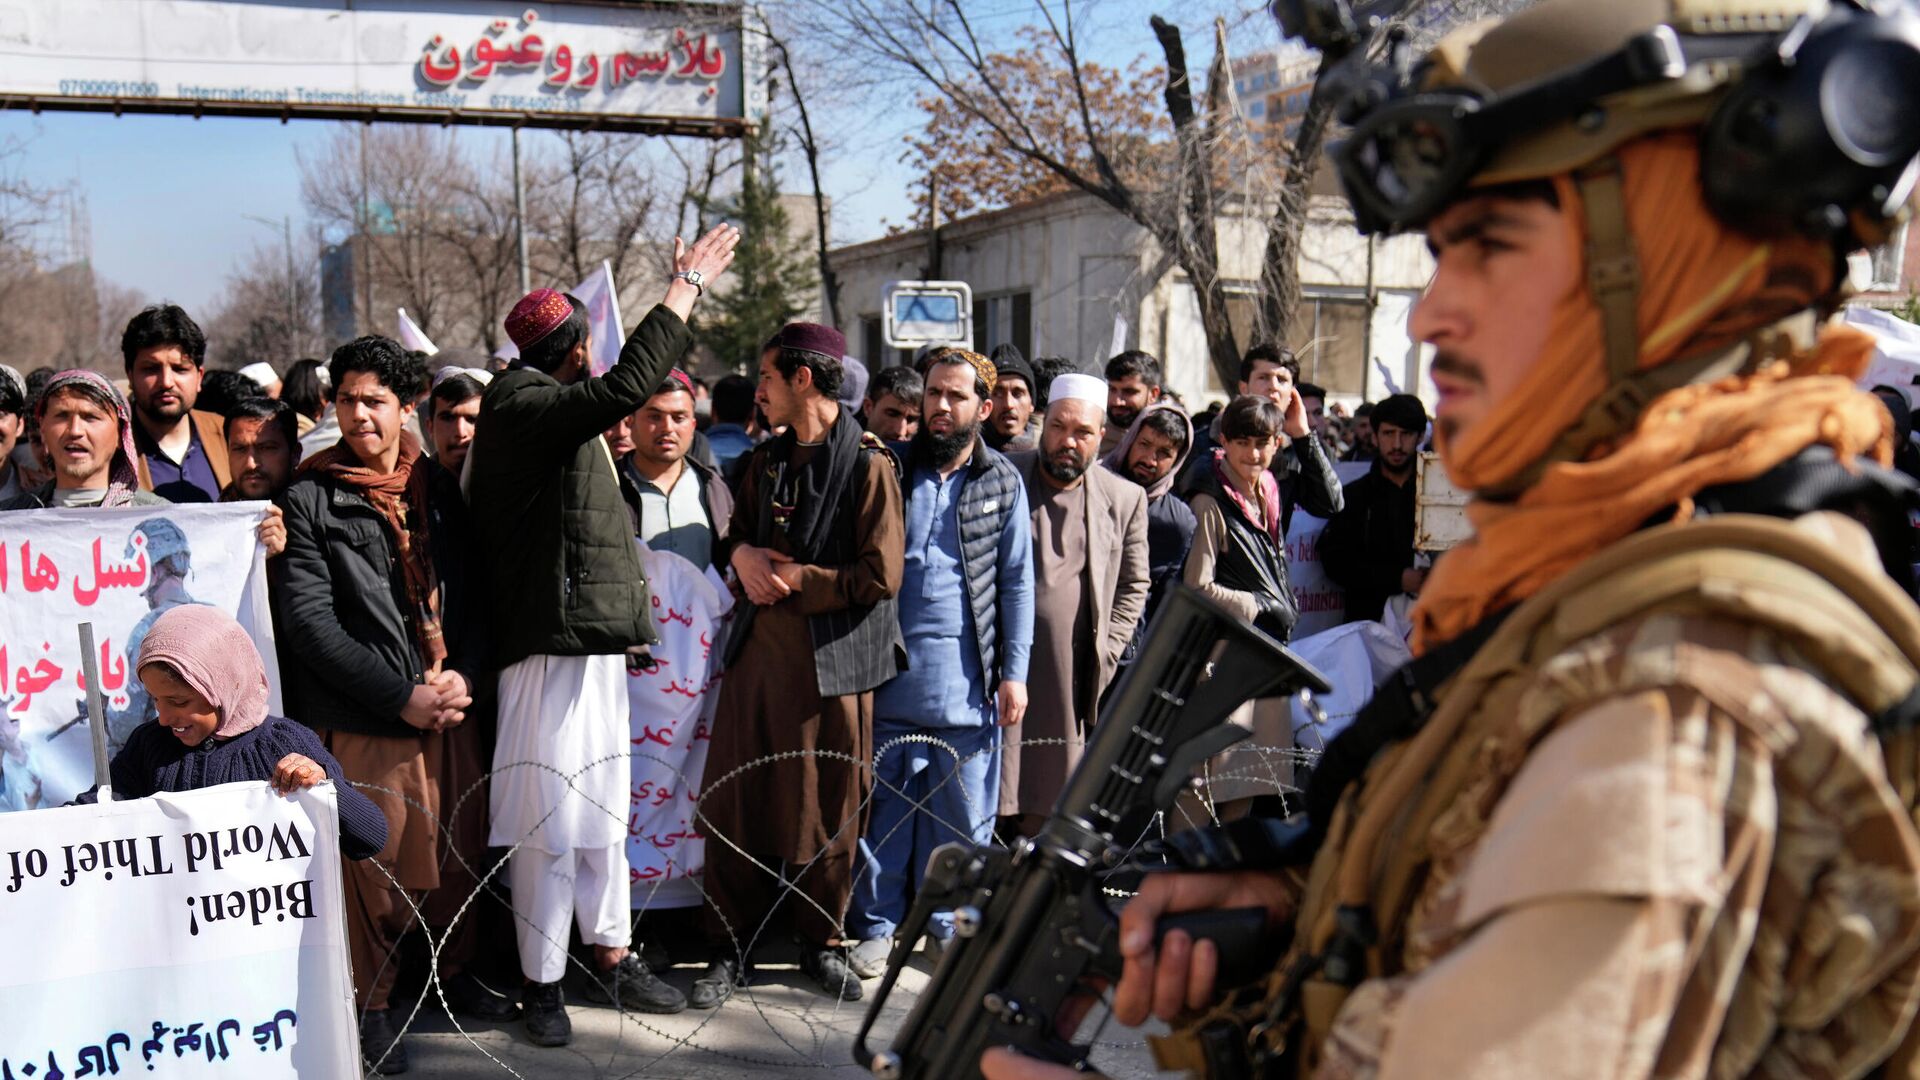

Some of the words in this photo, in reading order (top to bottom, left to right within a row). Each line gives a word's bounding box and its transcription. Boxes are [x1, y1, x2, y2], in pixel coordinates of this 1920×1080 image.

[421, 9, 600, 88] روغتون
[177, 83, 289, 102] International
[295, 87, 405, 106] Telemedicine
[411, 89, 467, 109] Center
[20, 539, 60, 592] ها
[73, 535, 147, 606] نسل
[6, 848, 48, 894] of
[59, 834, 173, 888] Thief
[182, 820, 311, 873] World
[185, 879, 317, 937] Biden!
[251, 1009, 298, 1054] غل
